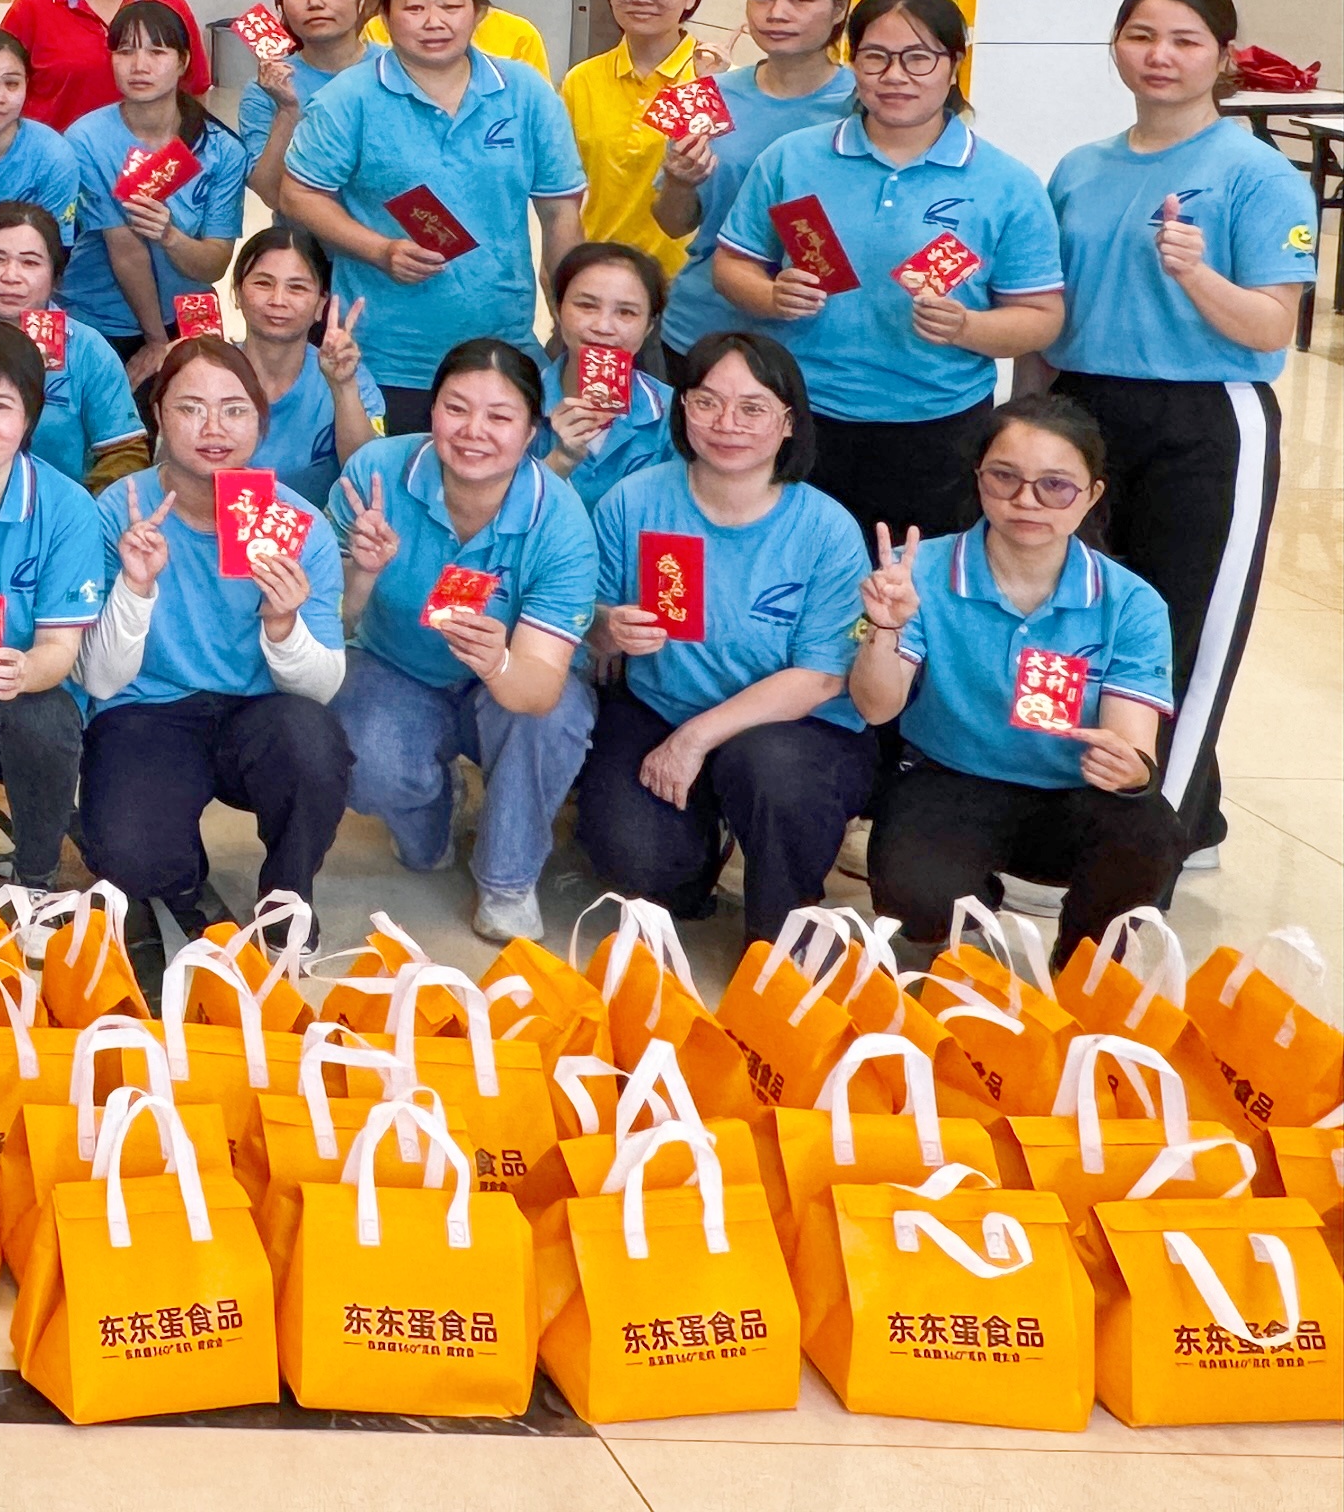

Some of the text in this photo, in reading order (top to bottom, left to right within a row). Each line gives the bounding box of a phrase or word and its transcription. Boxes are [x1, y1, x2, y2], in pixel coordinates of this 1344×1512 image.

[97, 1298, 244, 1348] 东东蛋食品
[342, 1303, 498, 1344] 东东蛋食品
[620, 1308, 768, 1354] 东东蛋食品
[887, 1311, 1045, 1350] 东东蛋食品
